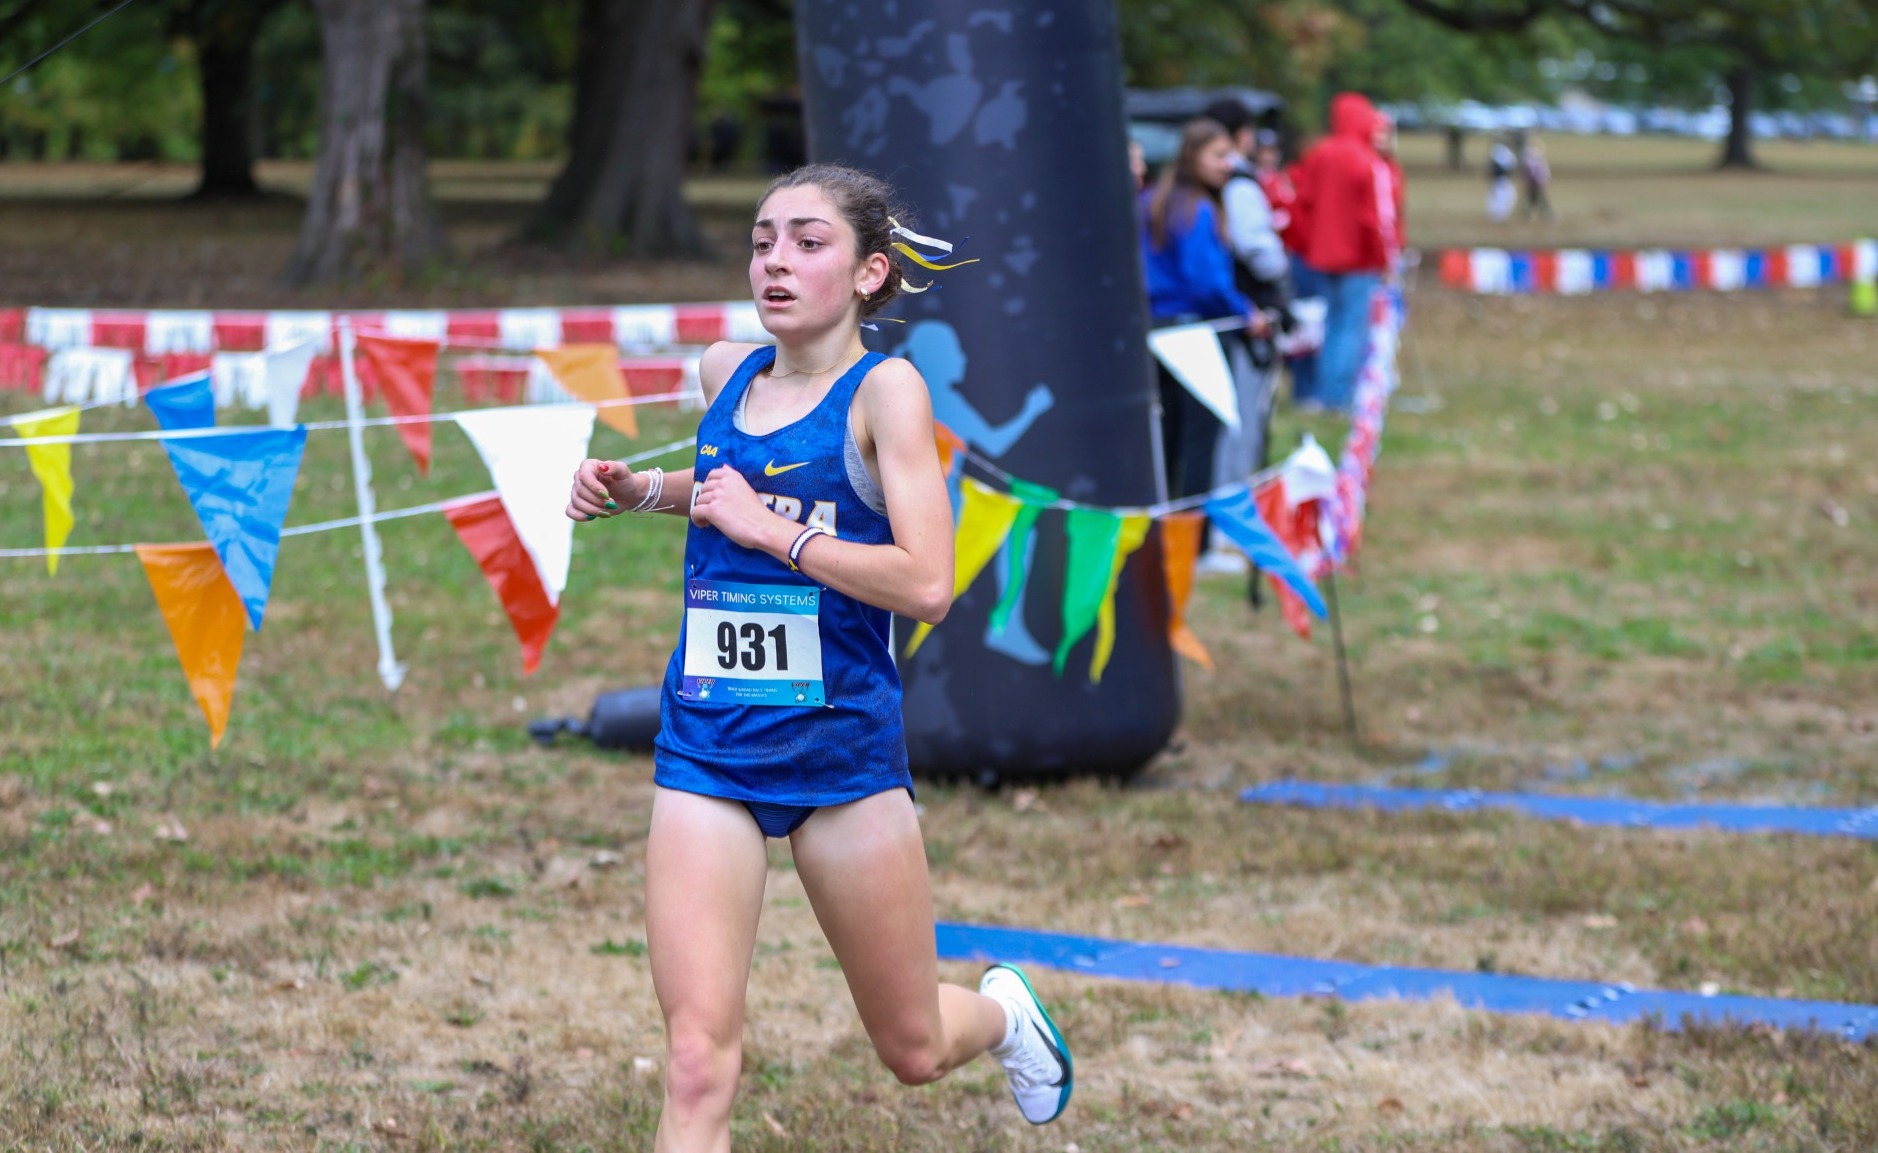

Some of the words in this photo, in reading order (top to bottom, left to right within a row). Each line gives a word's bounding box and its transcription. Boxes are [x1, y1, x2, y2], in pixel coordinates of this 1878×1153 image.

[700, 444, 718, 457] CAA
[689, 589, 719, 601] VIPER
[721, 591, 756, 604] TIMING
[760, 594, 816, 606] SYSTEMS
[717, 621, 788, 671] 931
